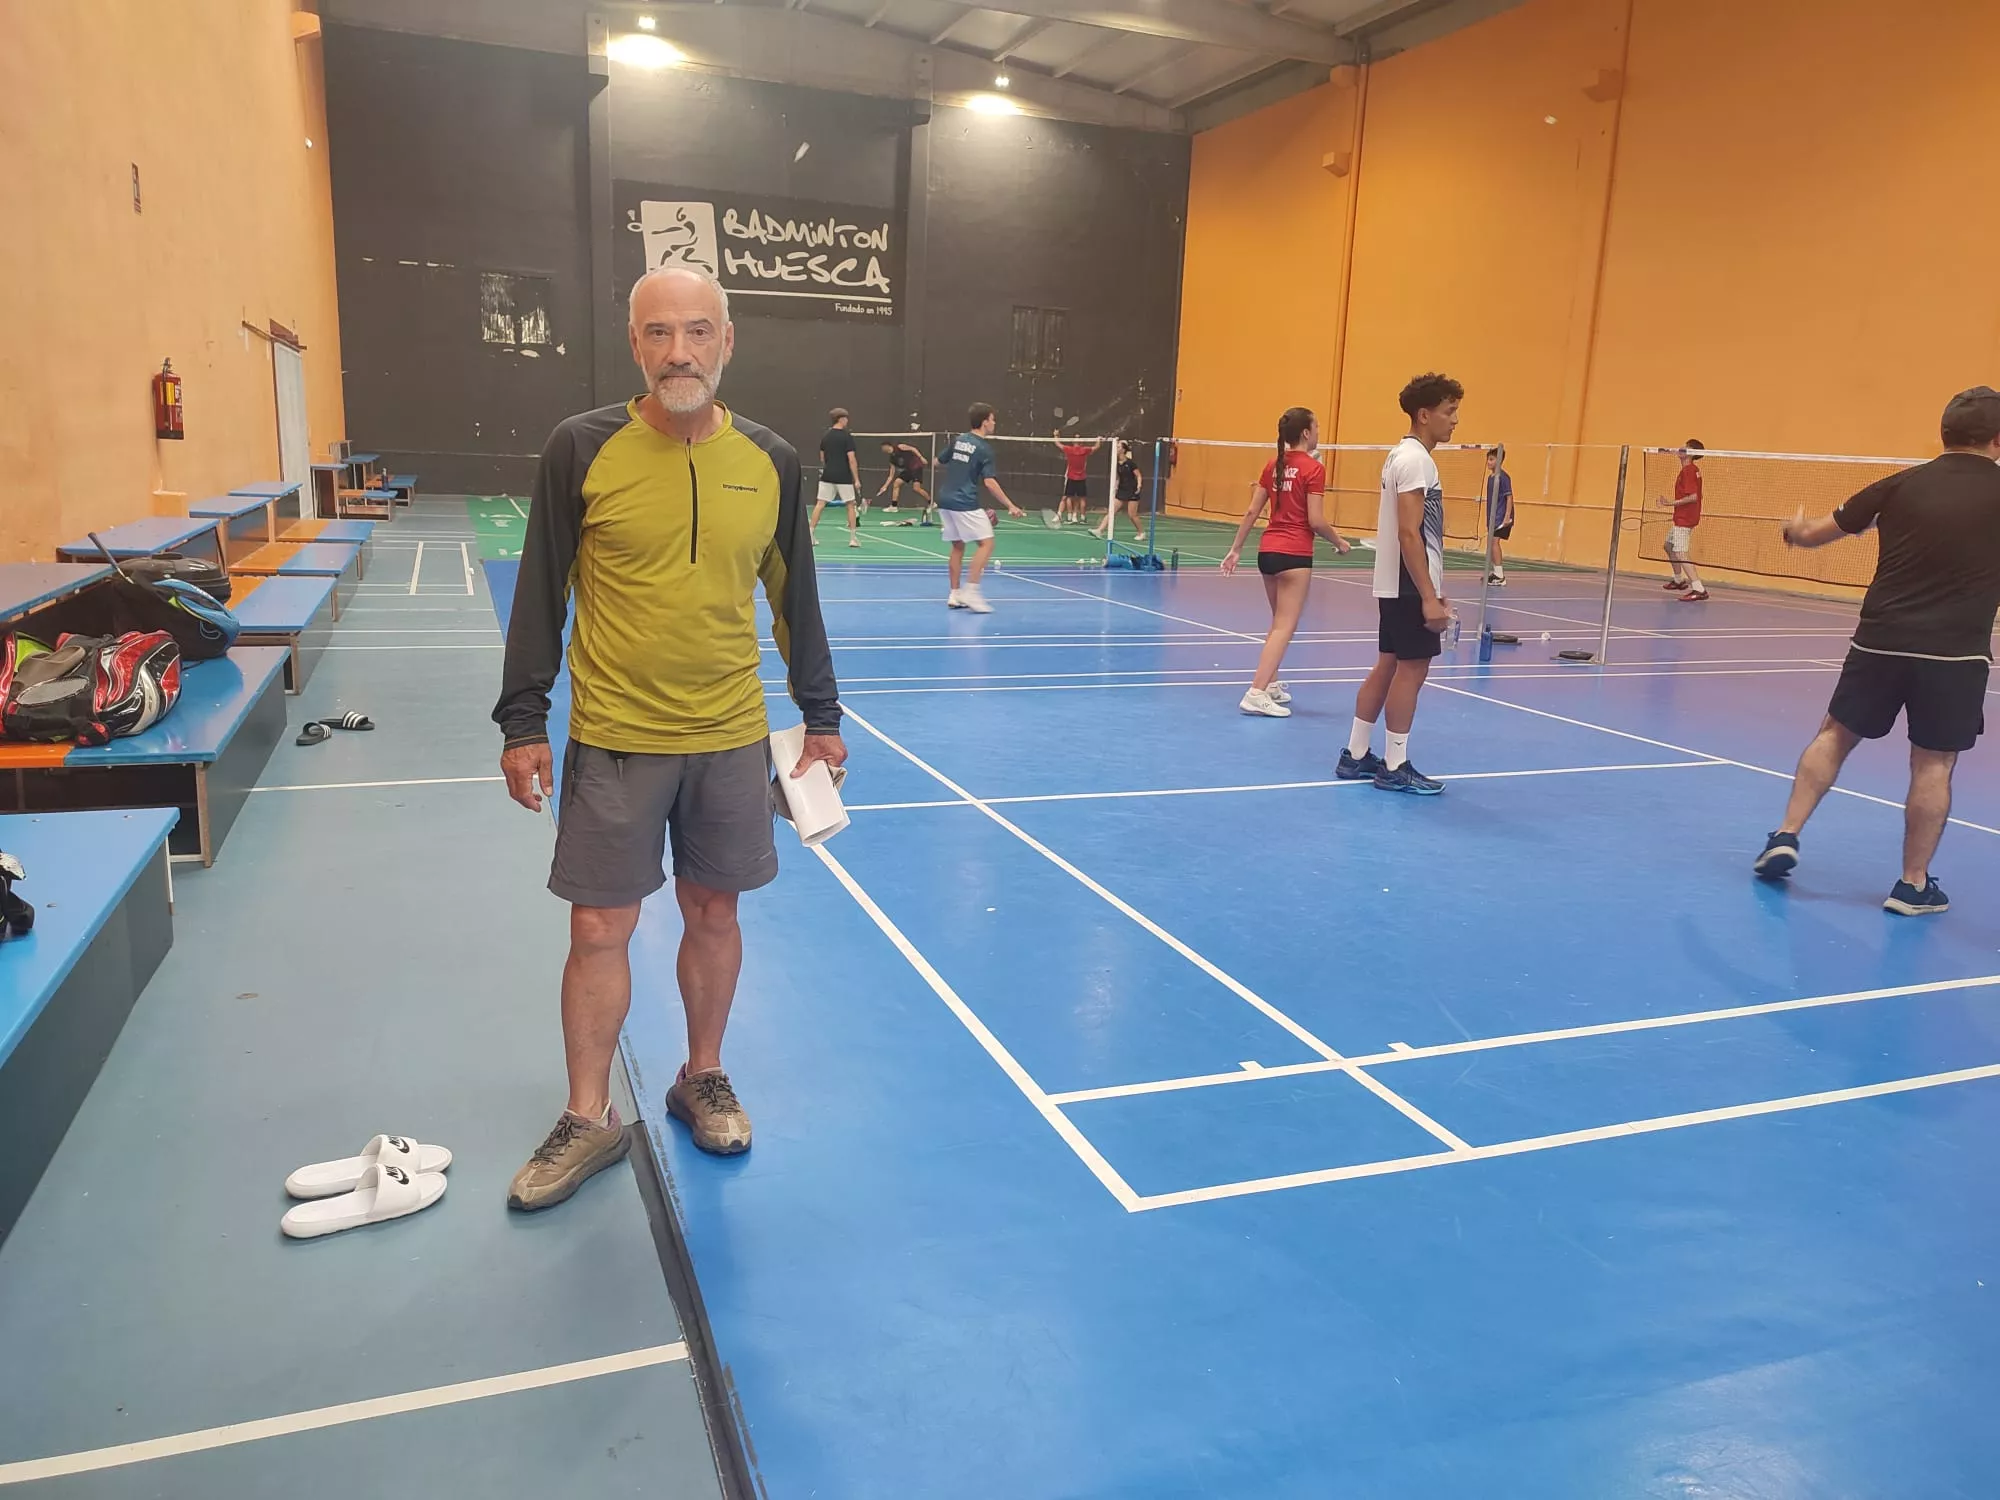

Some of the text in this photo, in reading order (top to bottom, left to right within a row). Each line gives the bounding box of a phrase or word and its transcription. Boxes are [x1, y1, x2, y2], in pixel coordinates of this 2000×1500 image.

[724, 248, 890, 294] HUESCA
[835, 302, 865, 313] Fundado
[876, 306, 893, 316] 1995
